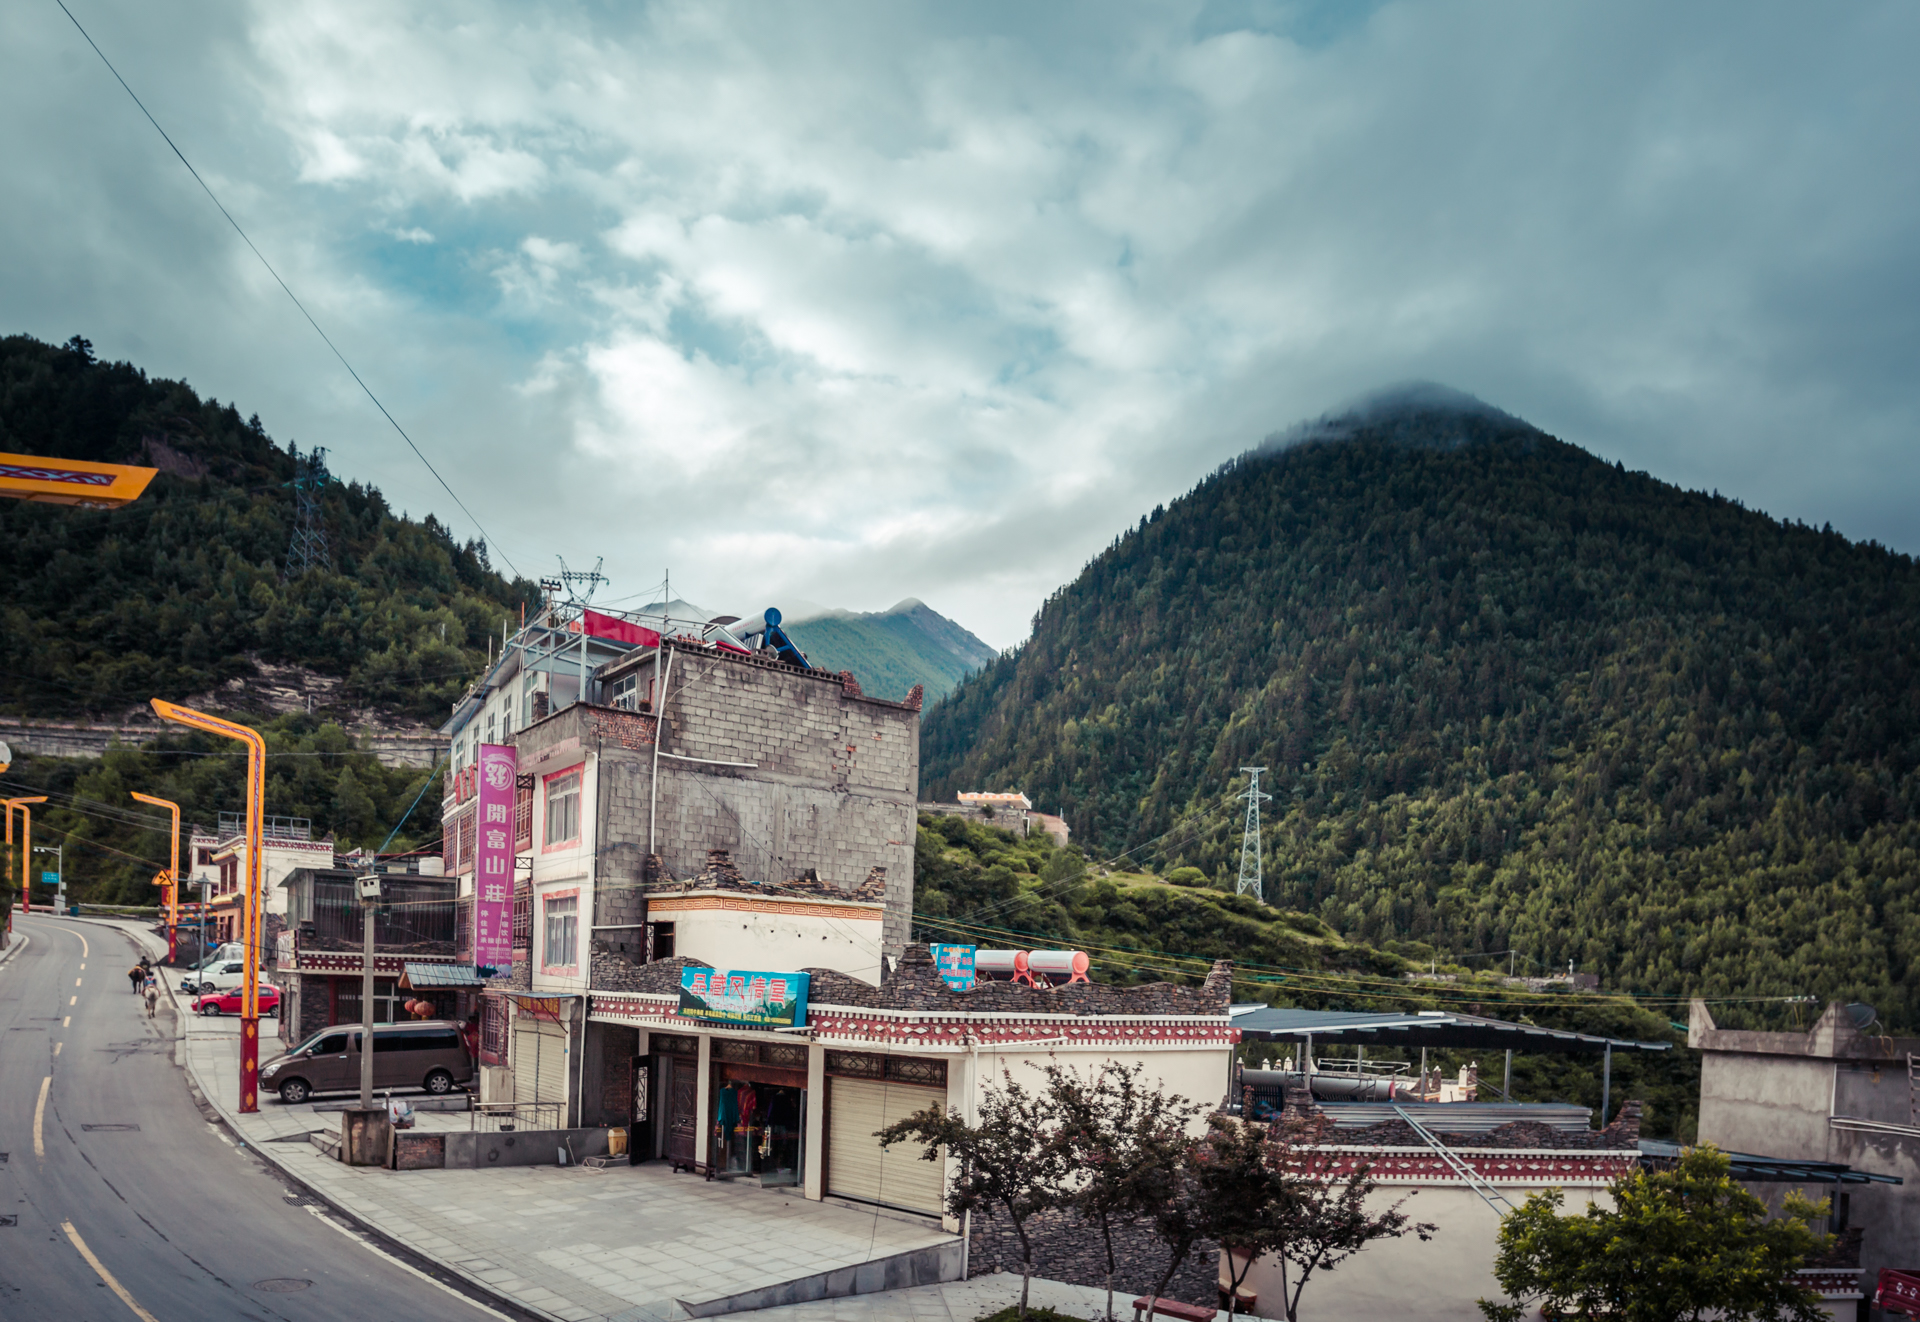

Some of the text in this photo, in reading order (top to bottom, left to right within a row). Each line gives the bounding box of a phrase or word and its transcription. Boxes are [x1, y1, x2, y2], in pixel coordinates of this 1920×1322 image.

[485, 803, 507, 903] 開富山莊
[691, 973, 787, 1009] 品藏风情屋
